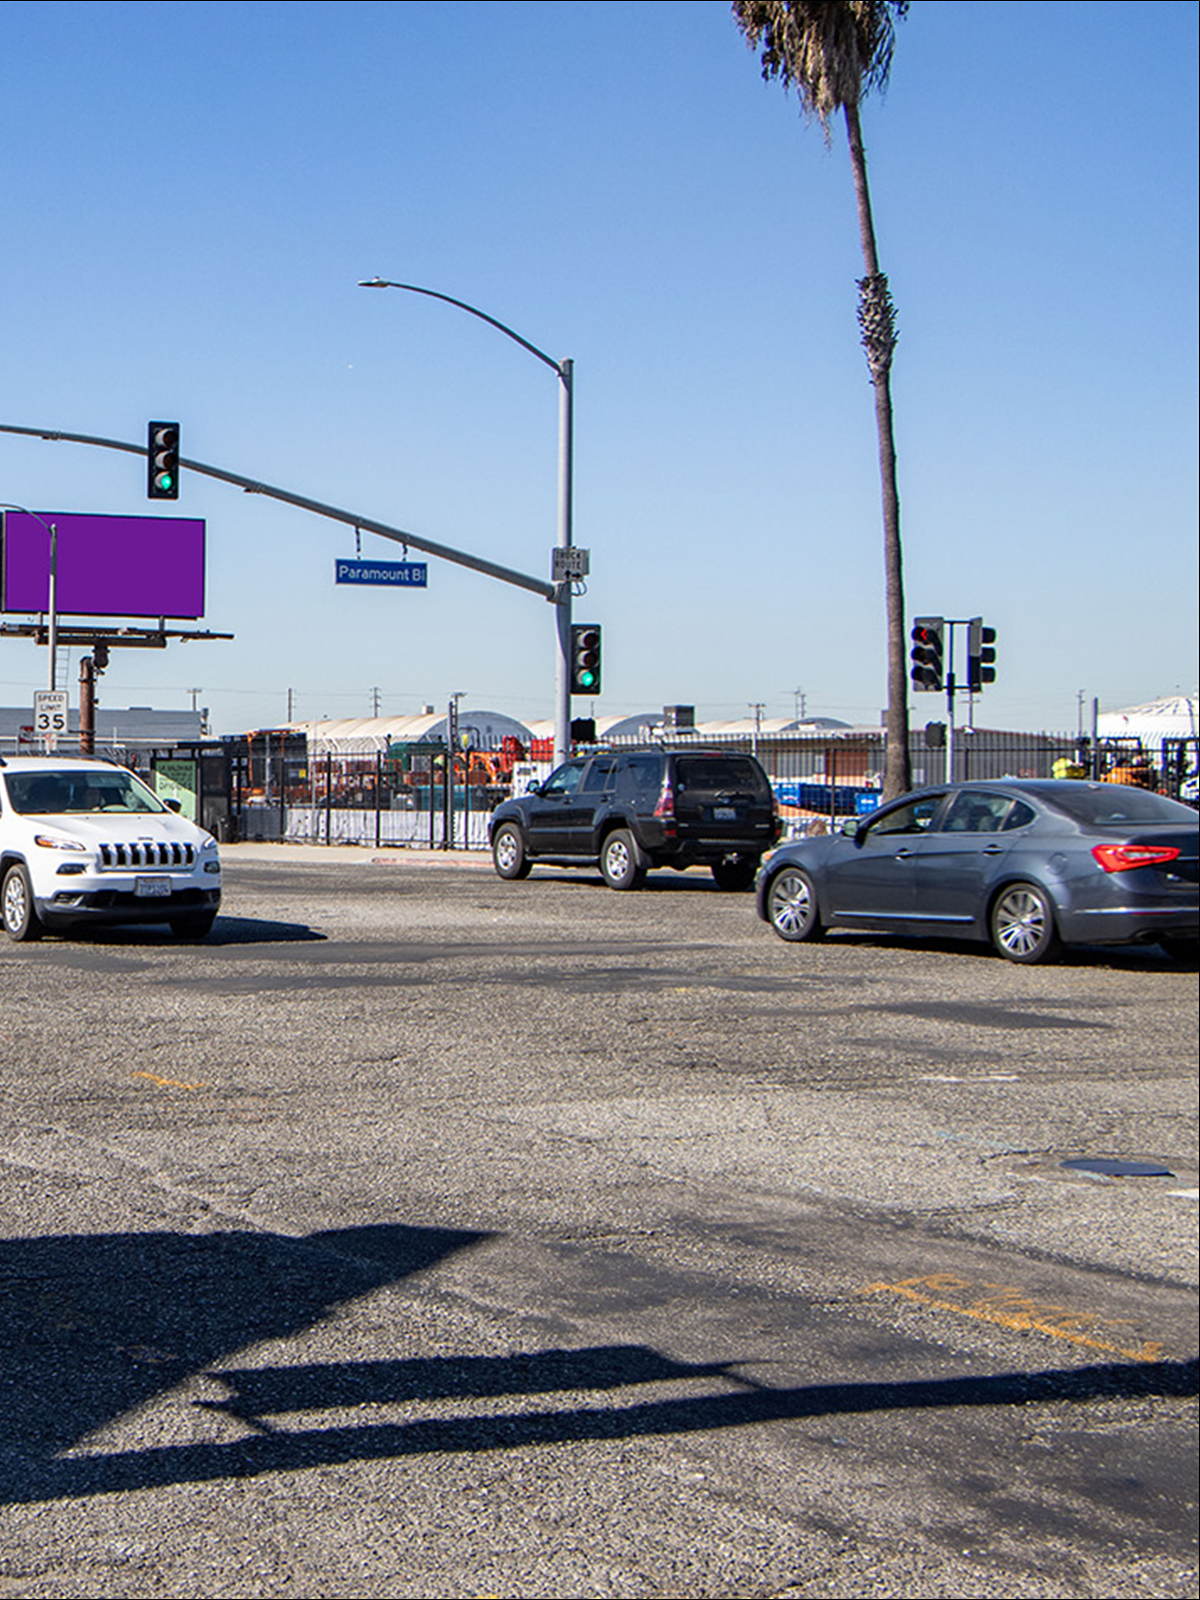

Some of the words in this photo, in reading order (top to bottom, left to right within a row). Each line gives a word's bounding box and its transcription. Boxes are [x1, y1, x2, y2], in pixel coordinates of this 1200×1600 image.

[339, 565, 410, 581] Paramount
[412, 568, 426, 582] Bl
[38, 694, 65, 702] SPEED
[41, 703, 62, 711] LIMIT
[38, 713, 65, 730] 35
